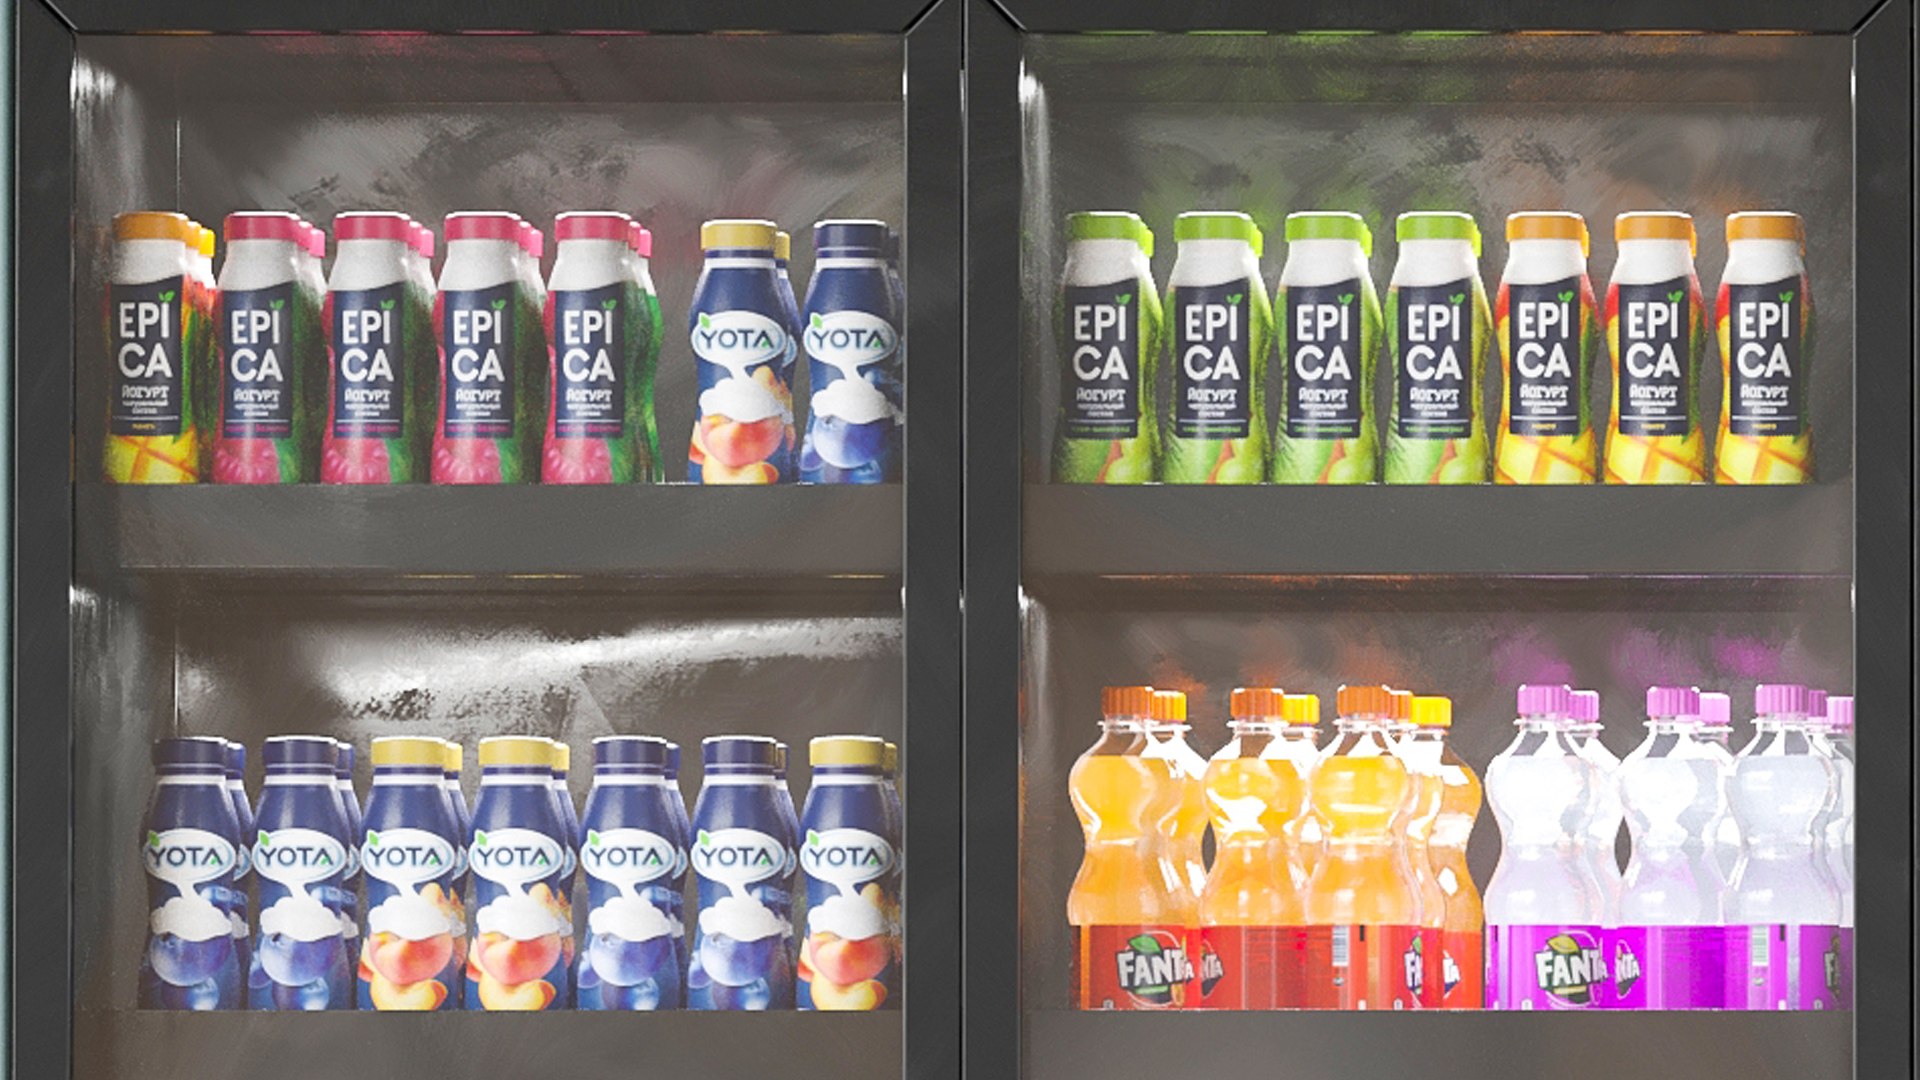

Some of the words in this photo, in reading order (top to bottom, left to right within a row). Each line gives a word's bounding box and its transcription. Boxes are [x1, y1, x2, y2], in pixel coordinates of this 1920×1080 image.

[121, 303, 169, 338] EPI
[232, 310, 280, 344] EPI
[343, 310, 390, 344] EPI
[454, 310, 501, 344] EPI
[564, 310, 612, 344] EPI
[1075, 305, 1126, 341] EPI
[1186, 305, 1237, 341] EPI
[1297, 305, 1348, 341] EPI
[1408, 305, 1459, 341] EPI
[1519, 302, 1568, 338] EPI
[1628, 302, 1677, 338] EPI
[1739, 302, 1788, 338] EPI
[700, 329, 772, 350] YOTA
[812, 329, 885, 350] YOTA
[119, 343, 173, 378] CA
[231, 349, 283, 382] CA
[341, 349, 394, 382] CA
[452, 349, 504, 382] CA
[563, 349, 615, 382] CA
[1073, 346, 1128, 381] CA
[1184, 346, 1240, 381] CA
[1295, 346, 1351, 381] CA
[1406, 346, 1462, 381] CA
[1517, 343, 1571, 378] CA
[1626, 343, 1680, 378] CA
[1737, 343, 1791, 378] CA
[152, 847, 222, 867] YOTA
[260, 847, 334, 867] YOTA
[369, 847, 443, 867] YOTA
[478, 847, 552, 867] YOTA
[589, 847, 663, 867] YOTA
[700, 847, 772, 867] YOTA
[809, 847, 883, 867] YOTA
[1536, 949, 1608, 987] FANTA
